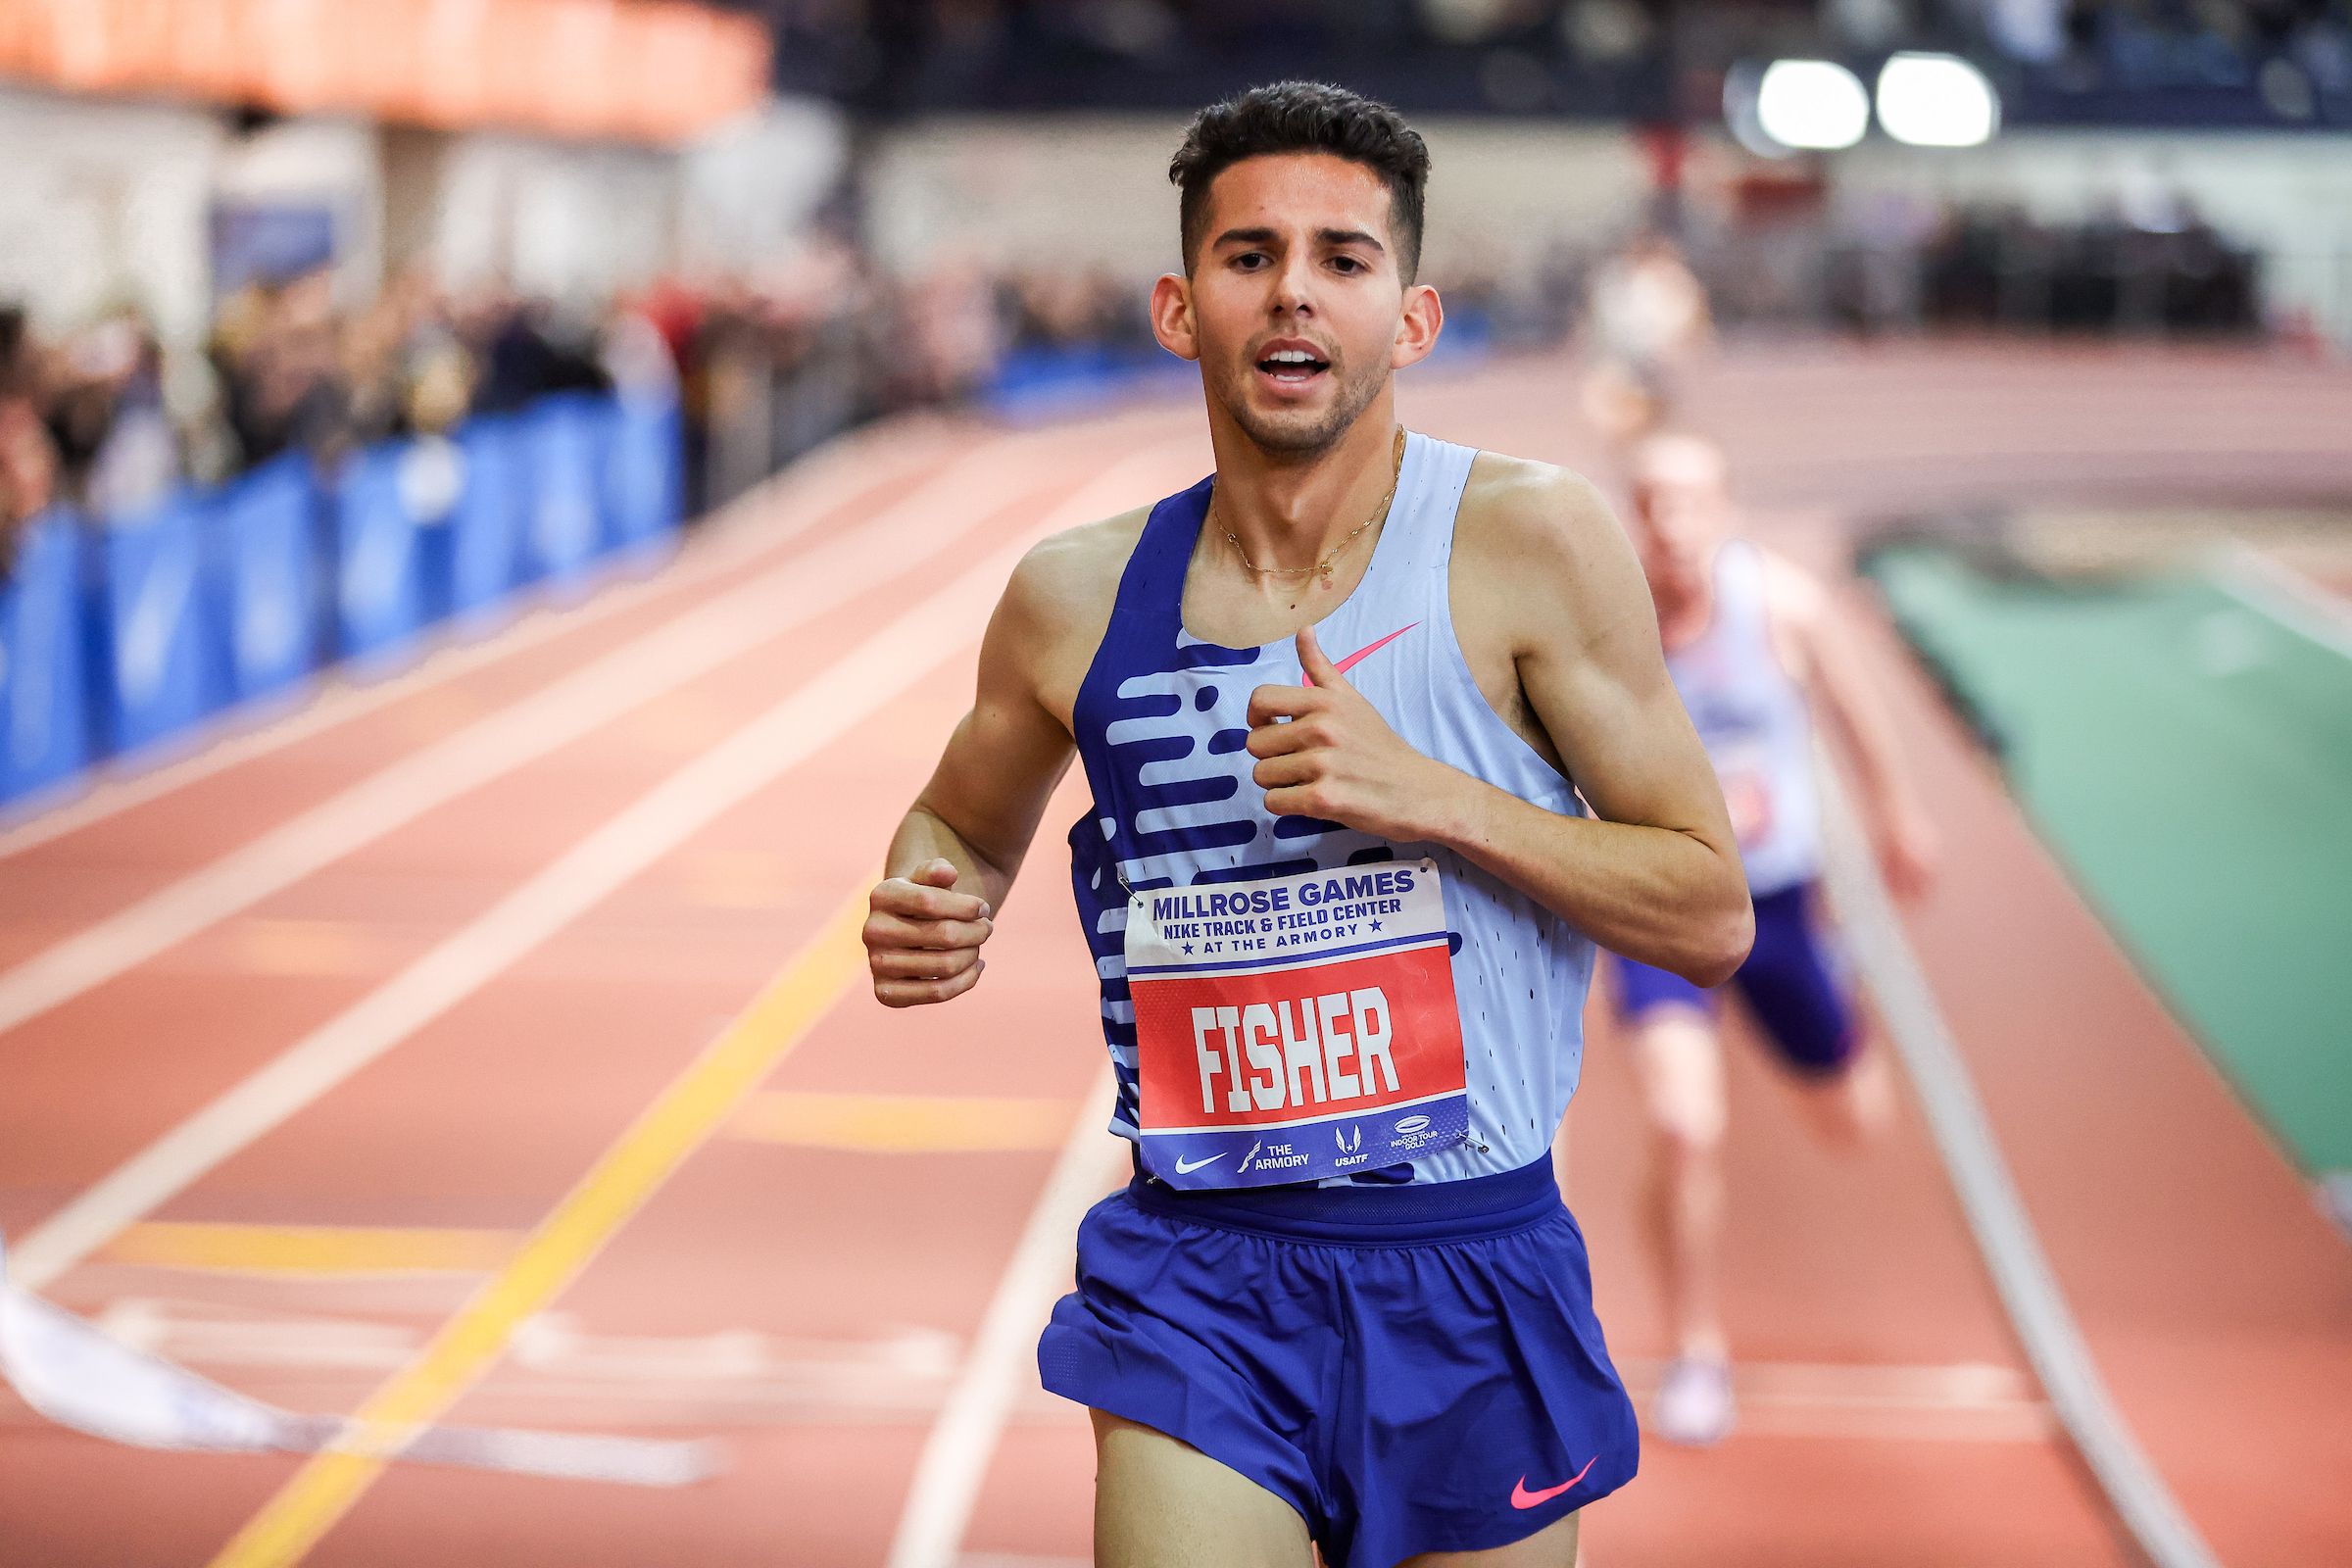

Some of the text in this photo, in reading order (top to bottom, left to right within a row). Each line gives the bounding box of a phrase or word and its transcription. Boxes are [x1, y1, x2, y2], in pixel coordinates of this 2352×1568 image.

[1153, 870, 1415, 921] MILLROSE GAMES
[1164, 899, 1401, 940] NIKE TRACK & FIELD CENTER
[1204, 923, 1357, 954] AT THE ARMORY
[1192, 986, 1400, 1114] FISHER
[1390, 1135, 1418, 1148] INDOOR
[1419, 1130, 1439, 1140] TOUR
[1405, 1140, 1425, 1151] GOLD
[1267, 1144, 1293, 1156] THE
[1255, 1153, 1309, 1171] ARMORY
[1335, 1153, 1369, 1167] USATF
